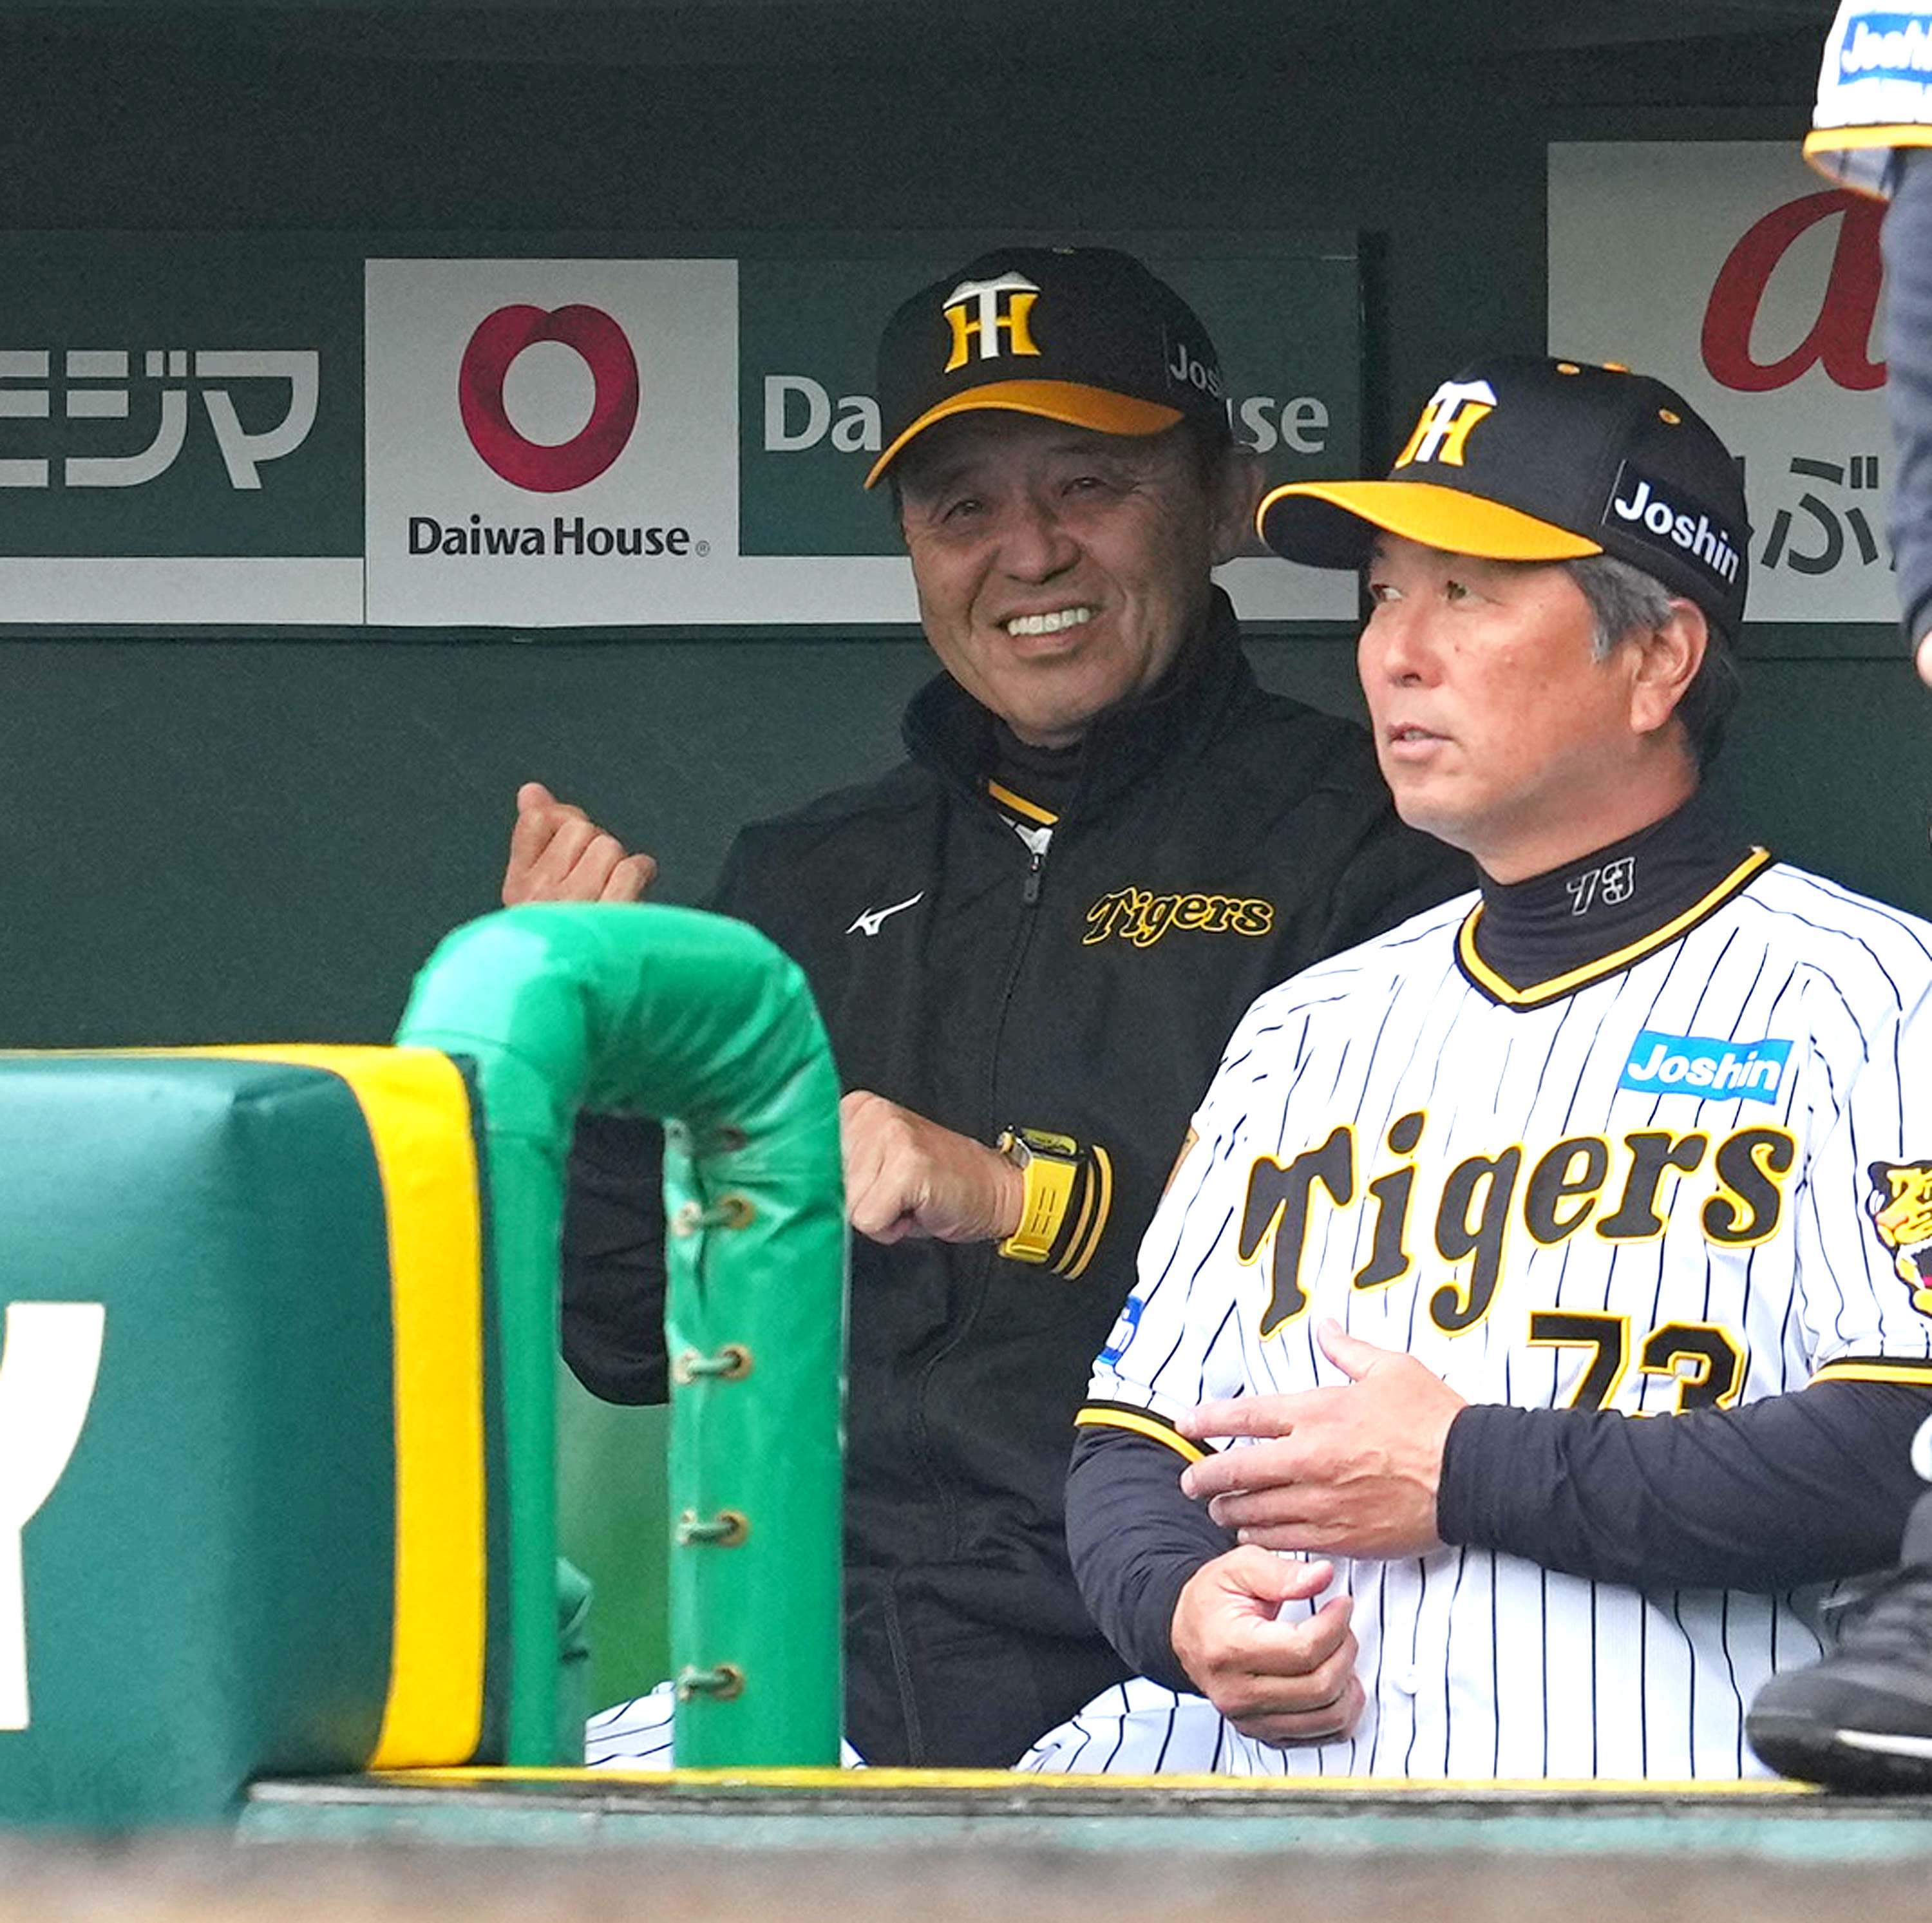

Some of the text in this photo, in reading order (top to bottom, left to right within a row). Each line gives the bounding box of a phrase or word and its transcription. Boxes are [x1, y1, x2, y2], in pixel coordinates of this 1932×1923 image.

[1170, 344, 1222, 397] Jos
[764, 375, 1329, 453] Da se
[409, 514, 690, 556] Daiwa House
[1615, 481, 1740, 584] Joshin
[1566, 857, 1635, 916] 73
[1082, 887, 1274, 947] Tigers
[1627, 1043, 1782, 1090] Joshin
[1236, 1110, 1797, 1343] Tigers
[1527, 1310, 1743, 1417] 73
